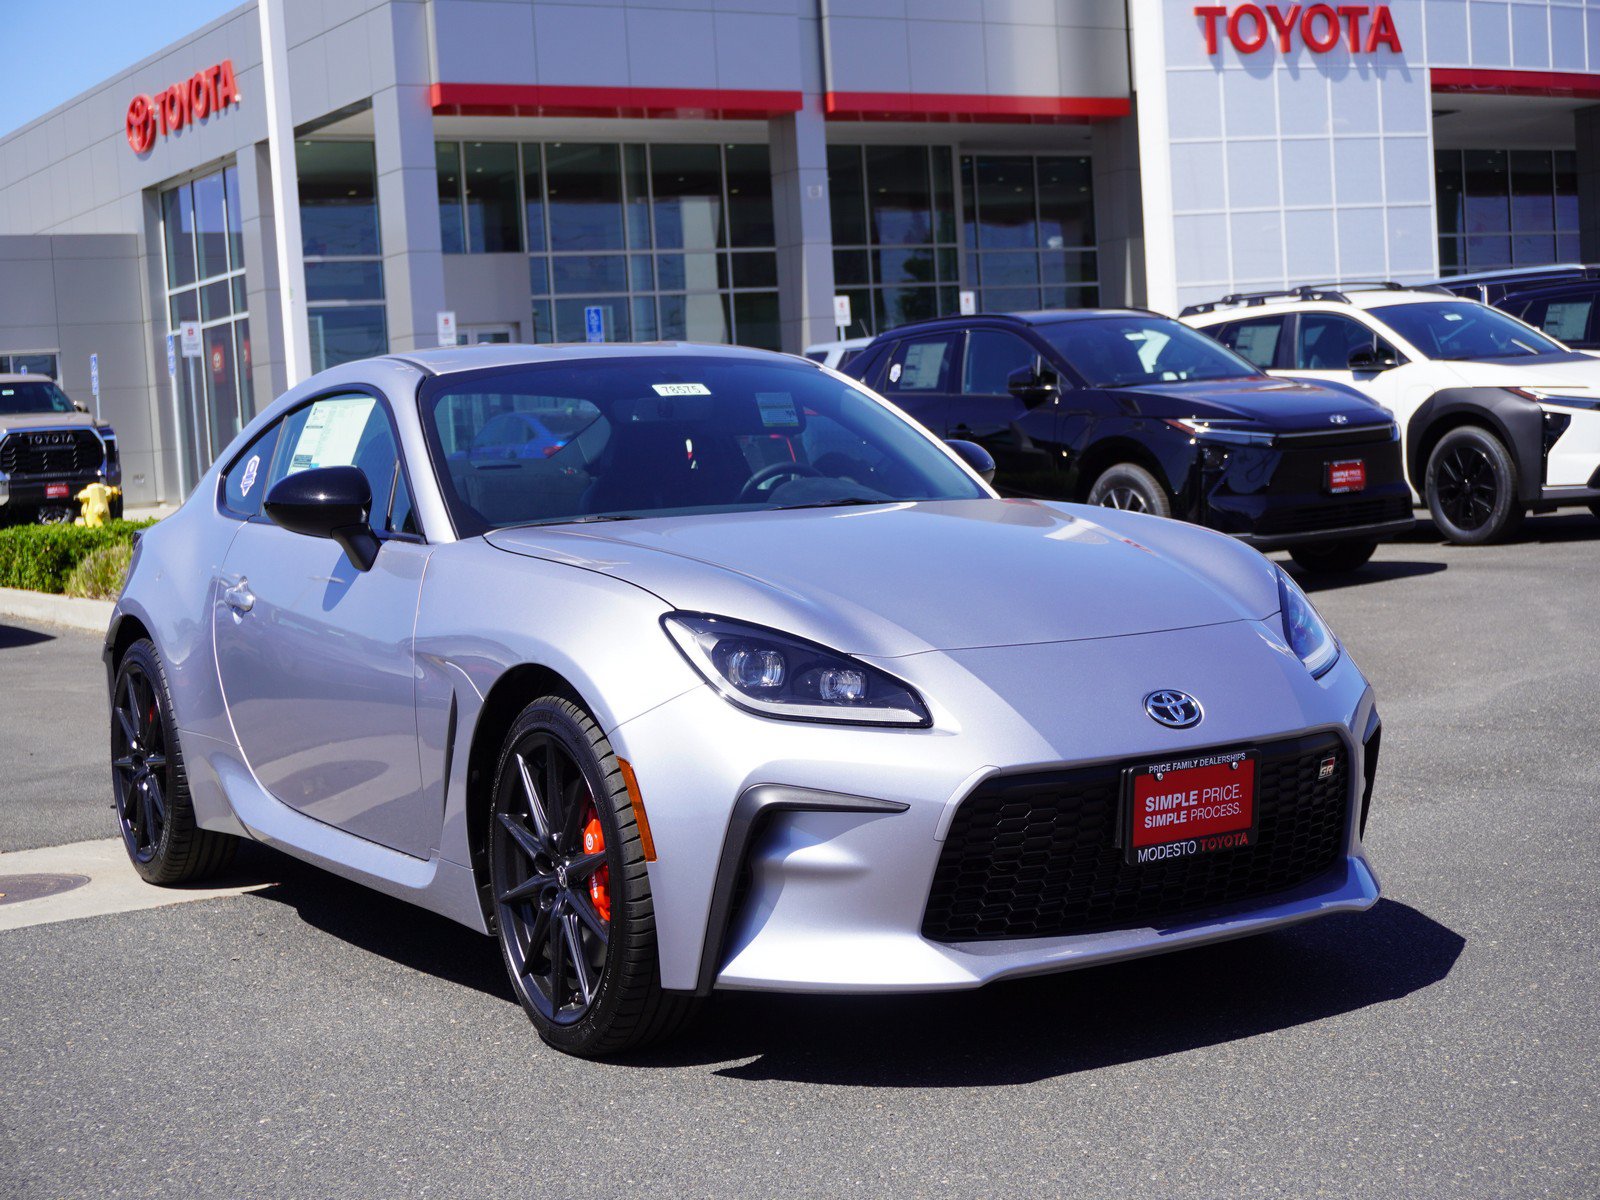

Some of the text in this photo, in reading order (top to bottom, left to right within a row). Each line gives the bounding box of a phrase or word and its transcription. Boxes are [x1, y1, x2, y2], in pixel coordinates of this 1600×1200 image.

[1194, 3, 1402, 54] TOYOTA
[154, 59, 237, 136] TOYOTA
[28, 433, 75, 445] TOYOTA
[1149, 752, 1246, 774] PRICE FAMILY DEALERSHIPS
[1320, 765, 1334, 777] GR
[1145, 783, 1242, 813] SIMPLE PRICE.
[1144, 802, 1242, 829] SIMPLE PROCESS.
[1138, 832, 1248, 863] MODESTO TOYOTA
